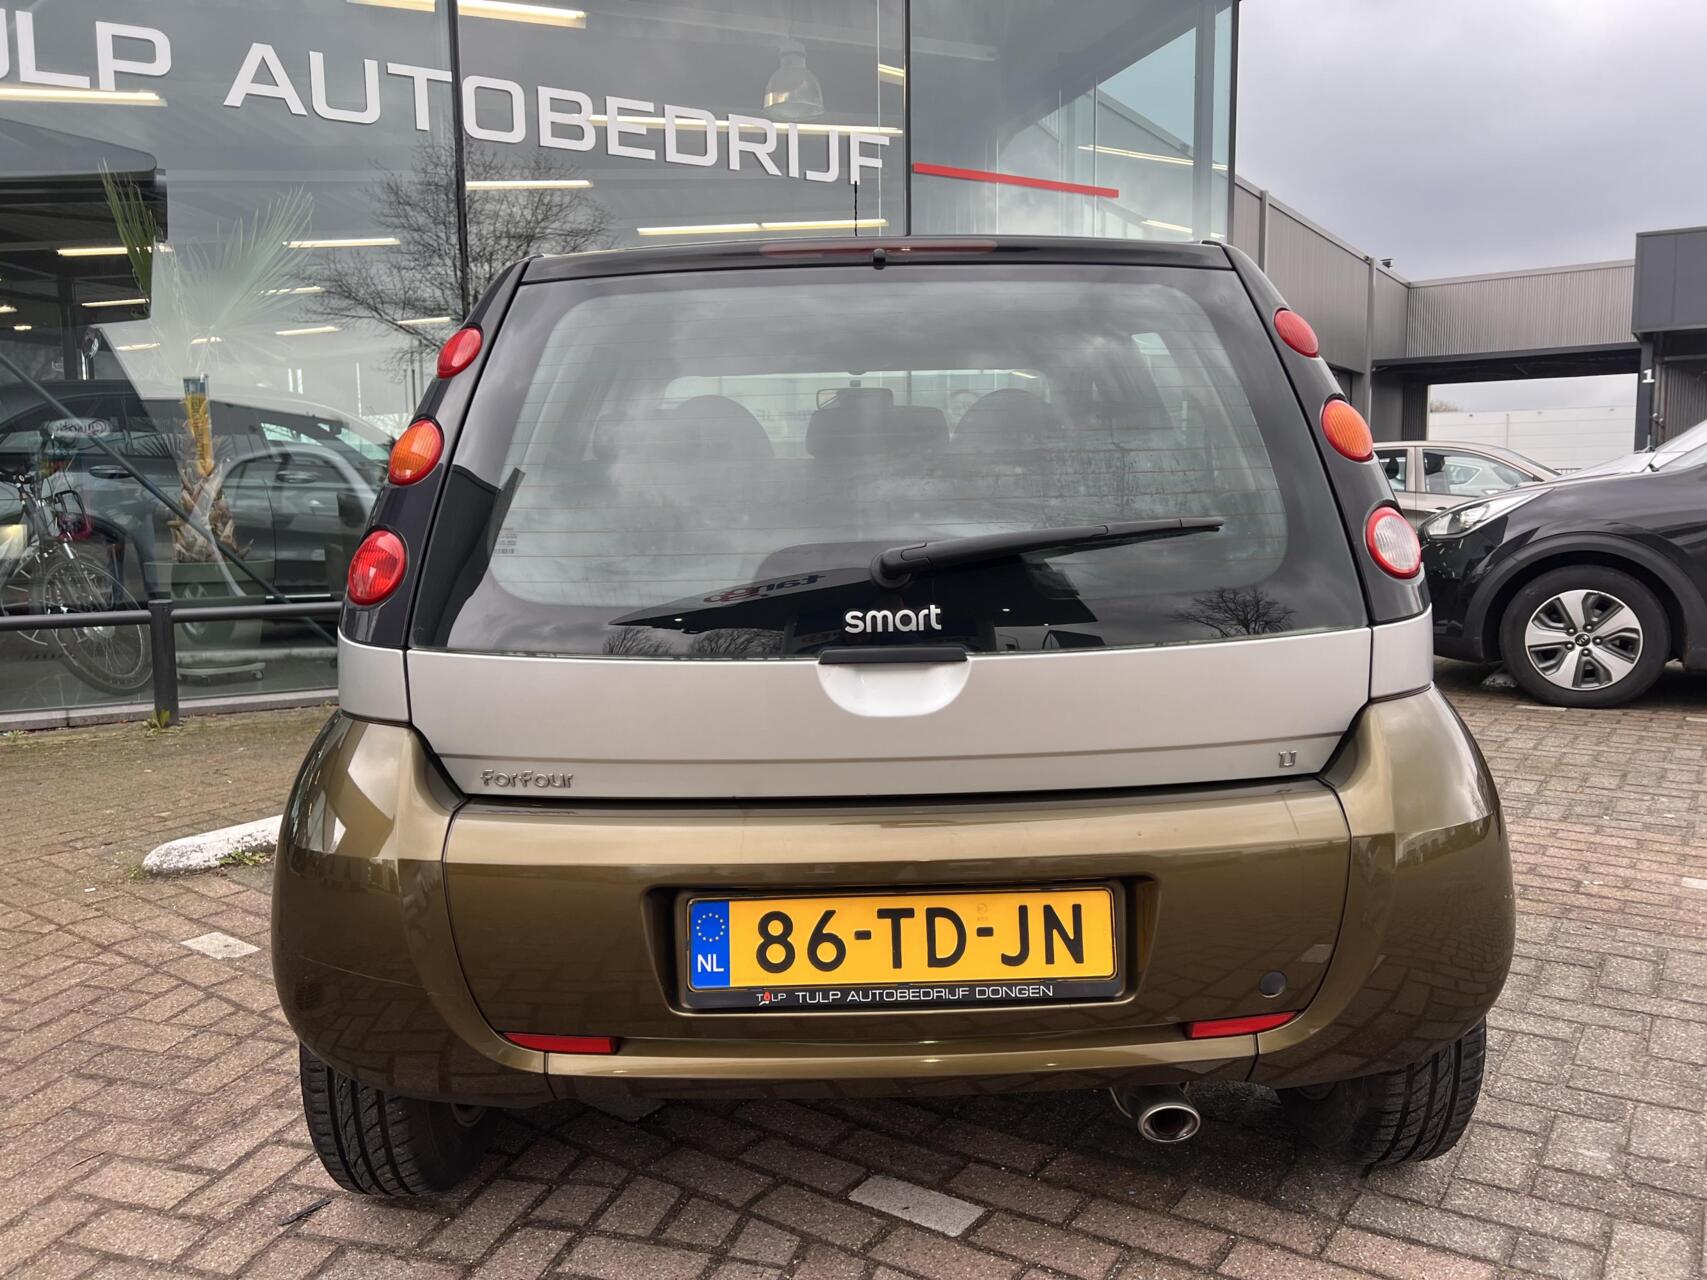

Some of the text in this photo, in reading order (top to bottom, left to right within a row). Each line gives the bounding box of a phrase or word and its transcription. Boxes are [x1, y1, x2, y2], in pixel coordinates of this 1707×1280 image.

[0, 8, 890, 185] LP AUTOBEDRIJF
[1642, 369, 1655, 383] 1
[844, 604, 942, 633] smart
[756, 903, 1084, 973] 86-TD-JN
[697, 954, 724, 972] NL
[795, 991, 841, 1003] TULP
[846, 987, 970, 1002] AUTOBEDRIJF
[975, 984, 1053, 998] DONGEN
